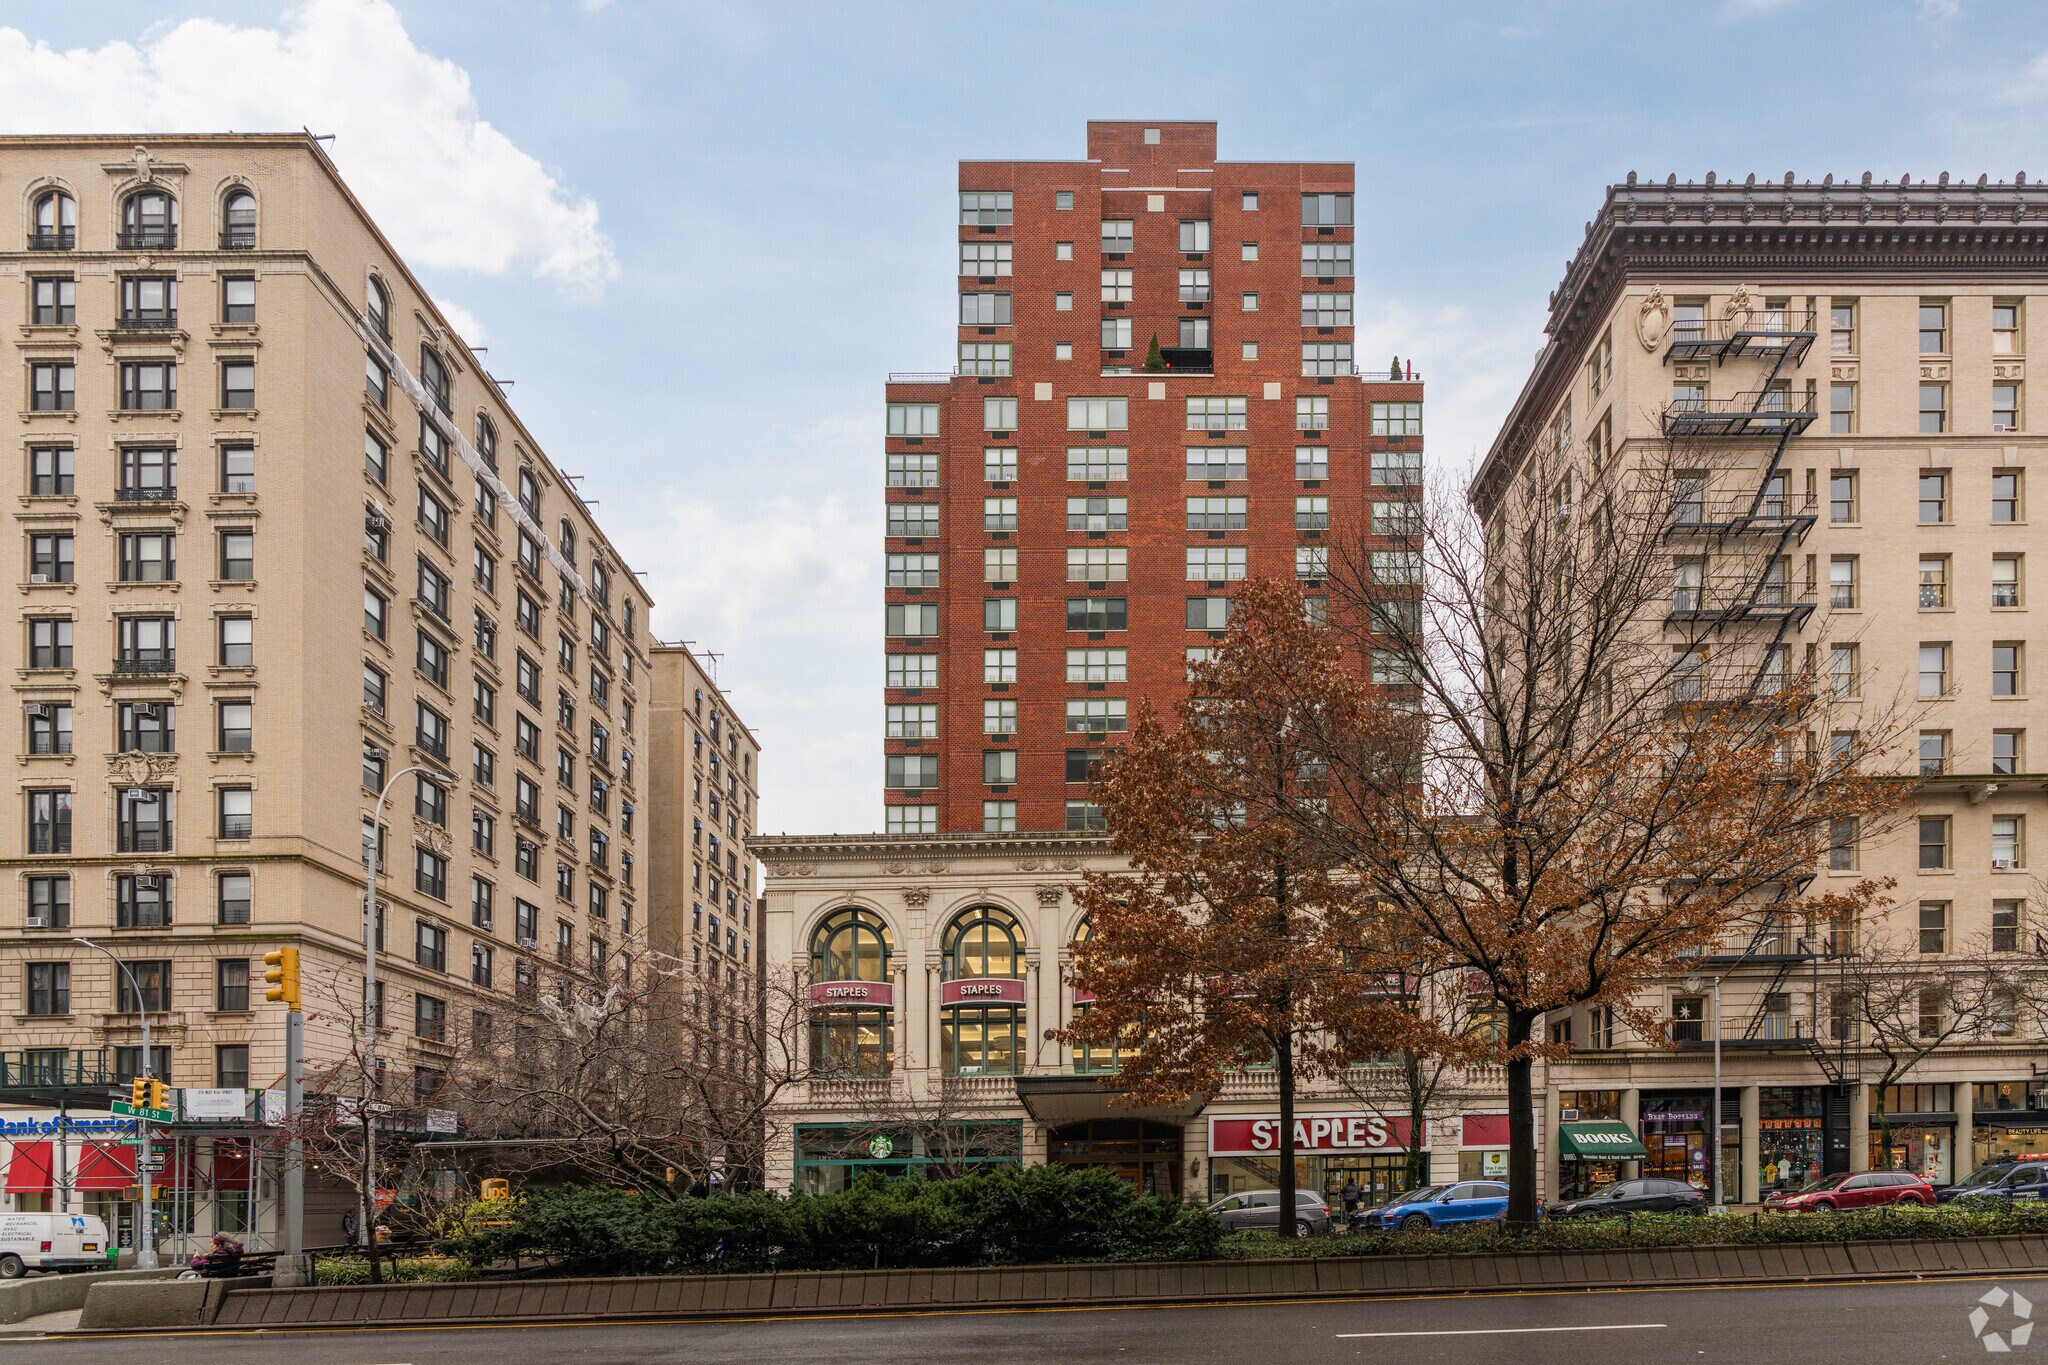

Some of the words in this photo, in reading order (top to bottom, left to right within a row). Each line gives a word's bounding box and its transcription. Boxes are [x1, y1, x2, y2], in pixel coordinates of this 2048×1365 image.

[826, 987, 868, 997] STAPLES
[960, 985, 1002, 995] STAPLES
[127, 1105, 136, 1114] W
[139, 1108, 149, 1117] 81
[151, 1110, 160, 1119] St
[41, 1115, 60, 1134] of
[121, 1138, 143, 1146] Broadway
[1572, 1133, 1633, 1144] BOOKS
